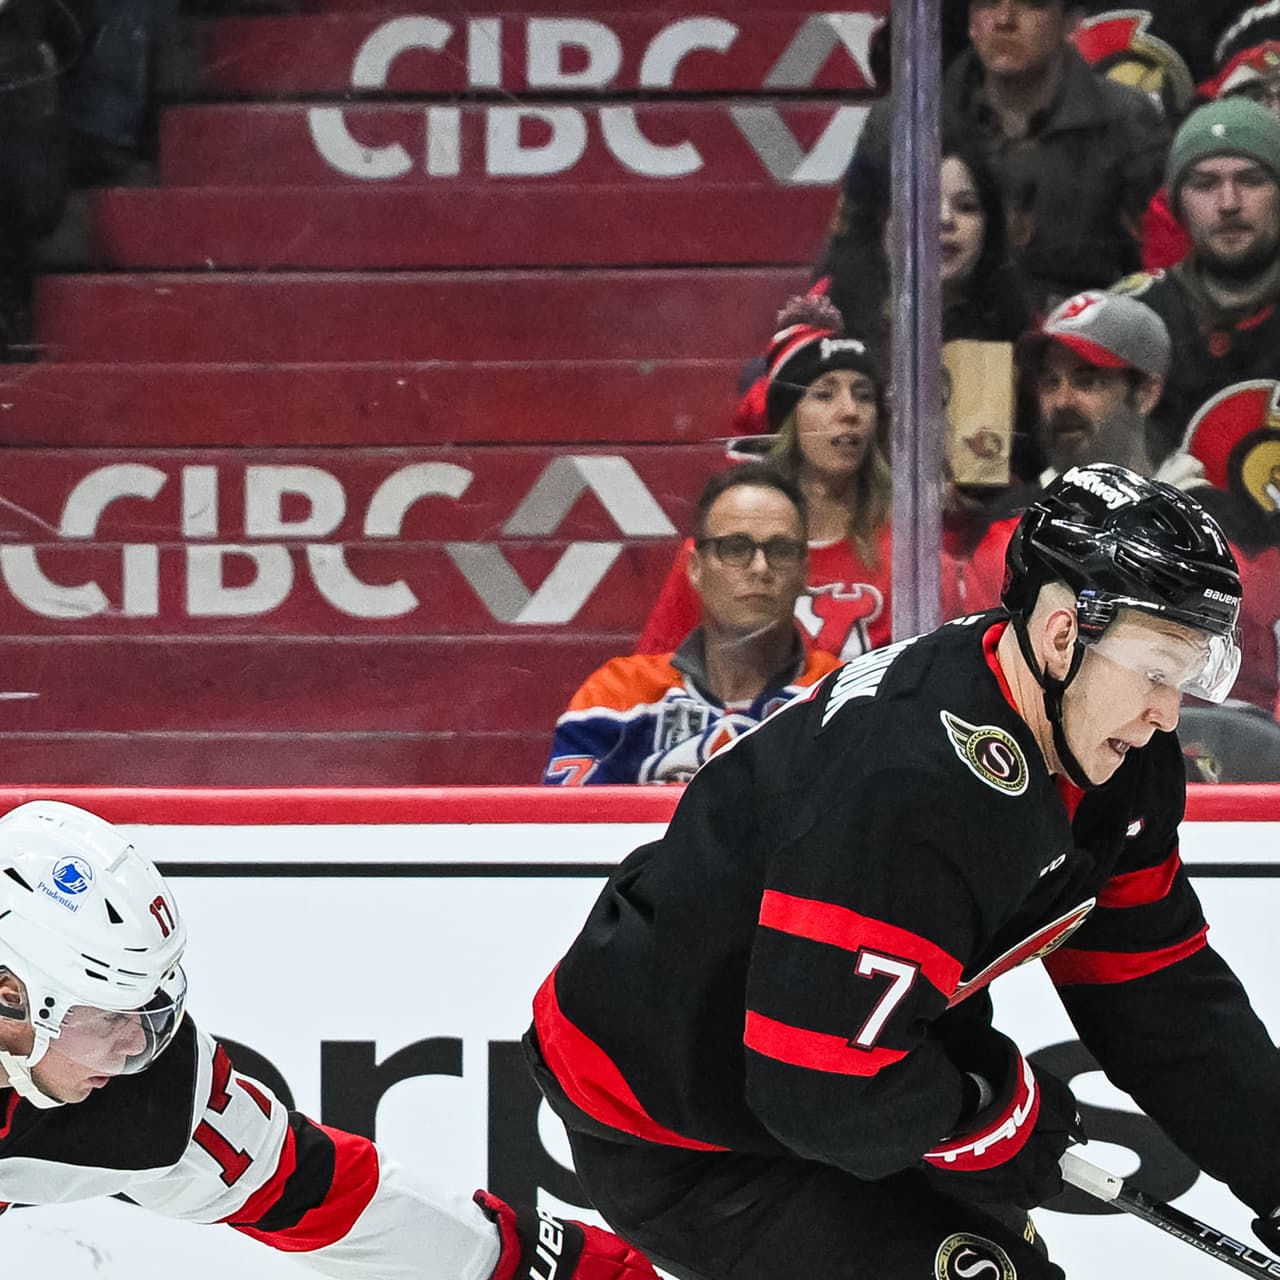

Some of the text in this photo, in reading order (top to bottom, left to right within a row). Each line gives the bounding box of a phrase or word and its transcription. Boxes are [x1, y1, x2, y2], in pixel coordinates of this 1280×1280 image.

[308, 16, 740, 180] CIBC
[36, 880, 79, 914] Prudential
[851, 949, 920, 1051] 7
